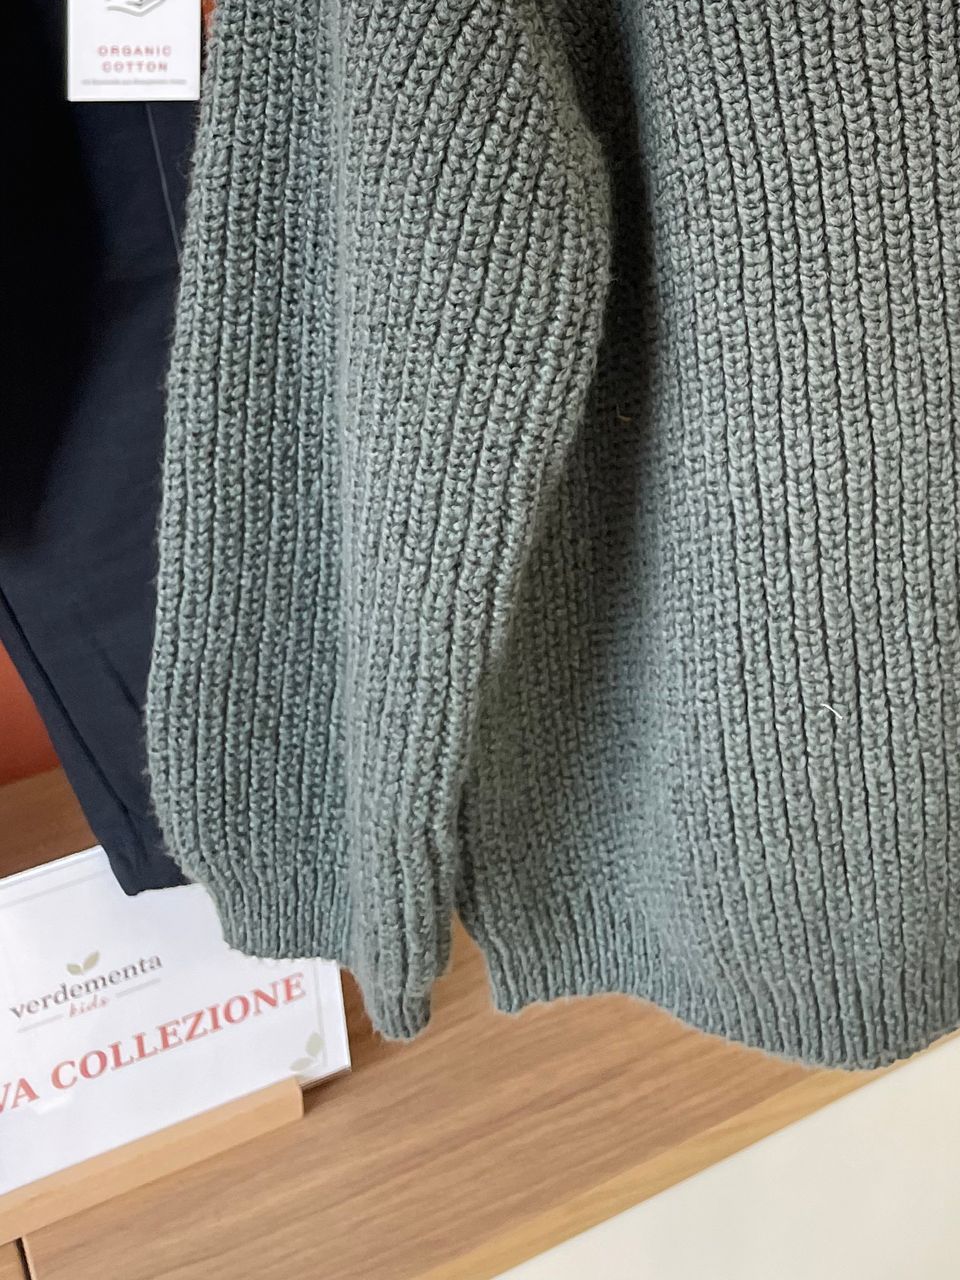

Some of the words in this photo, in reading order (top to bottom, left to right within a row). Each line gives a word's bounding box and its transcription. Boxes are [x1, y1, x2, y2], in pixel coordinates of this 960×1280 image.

[97, 44, 172, 57] ORGANIC
[102, 60, 168, 73] COTTON
[9, 955, 164, 1018] verdementa
[69, 993, 110, 1018] kids
[51, 972, 307, 1090] COLLEZIONE
